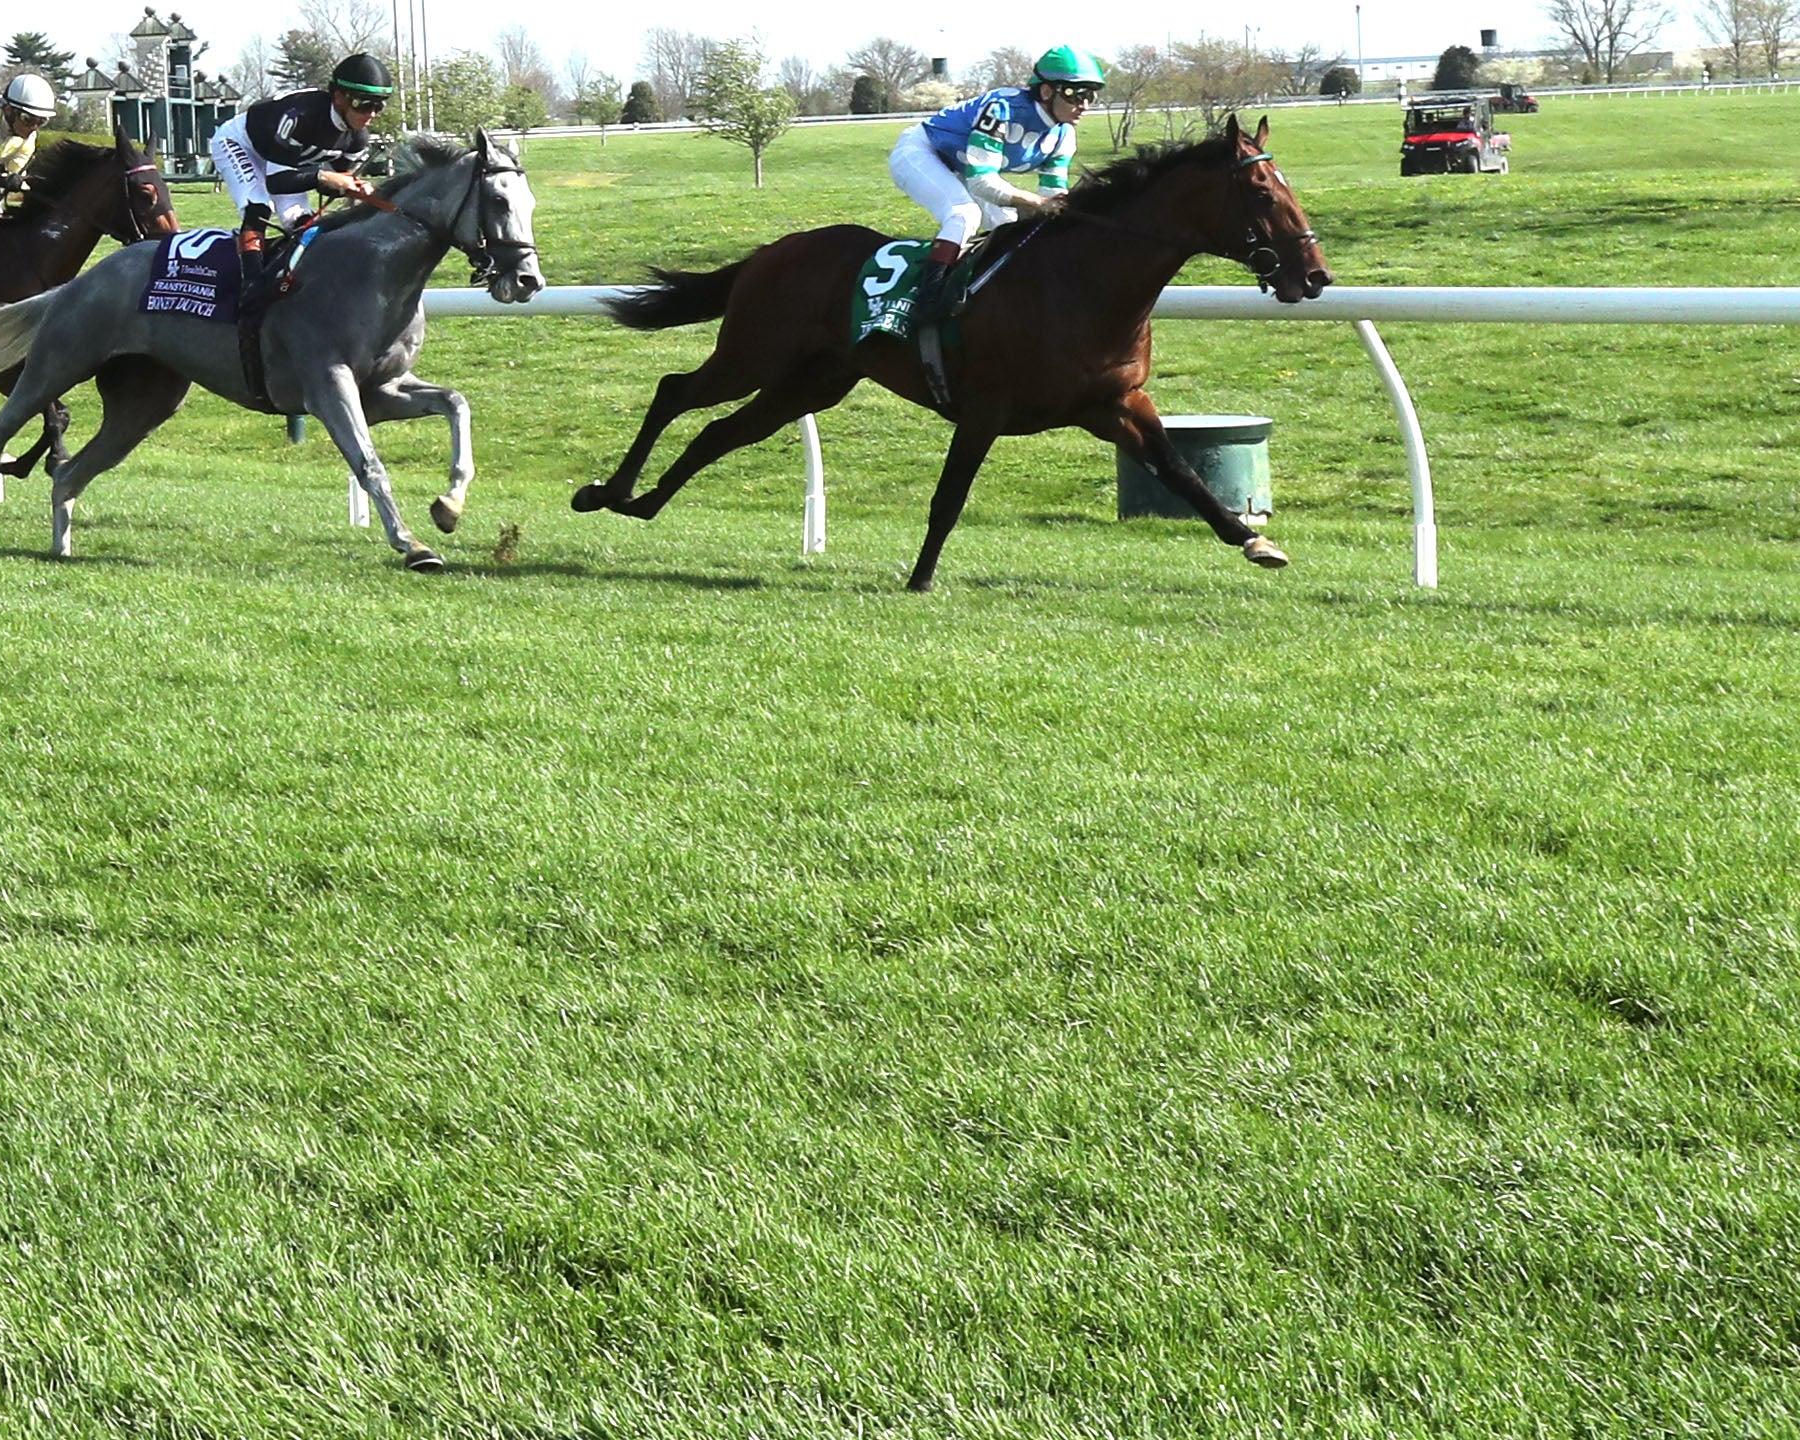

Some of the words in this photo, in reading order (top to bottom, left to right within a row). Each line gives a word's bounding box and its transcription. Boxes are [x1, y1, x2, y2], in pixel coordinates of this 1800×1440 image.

[276, 113, 295, 140] 10
[980, 102, 998, 131] 5
[167, 228, 233, 260] 10
[862, 239, 921, 297] 5
[153, 281, 216, 299] TRANSYLVANIA
[175, 297, 217, 318] DUTCH
